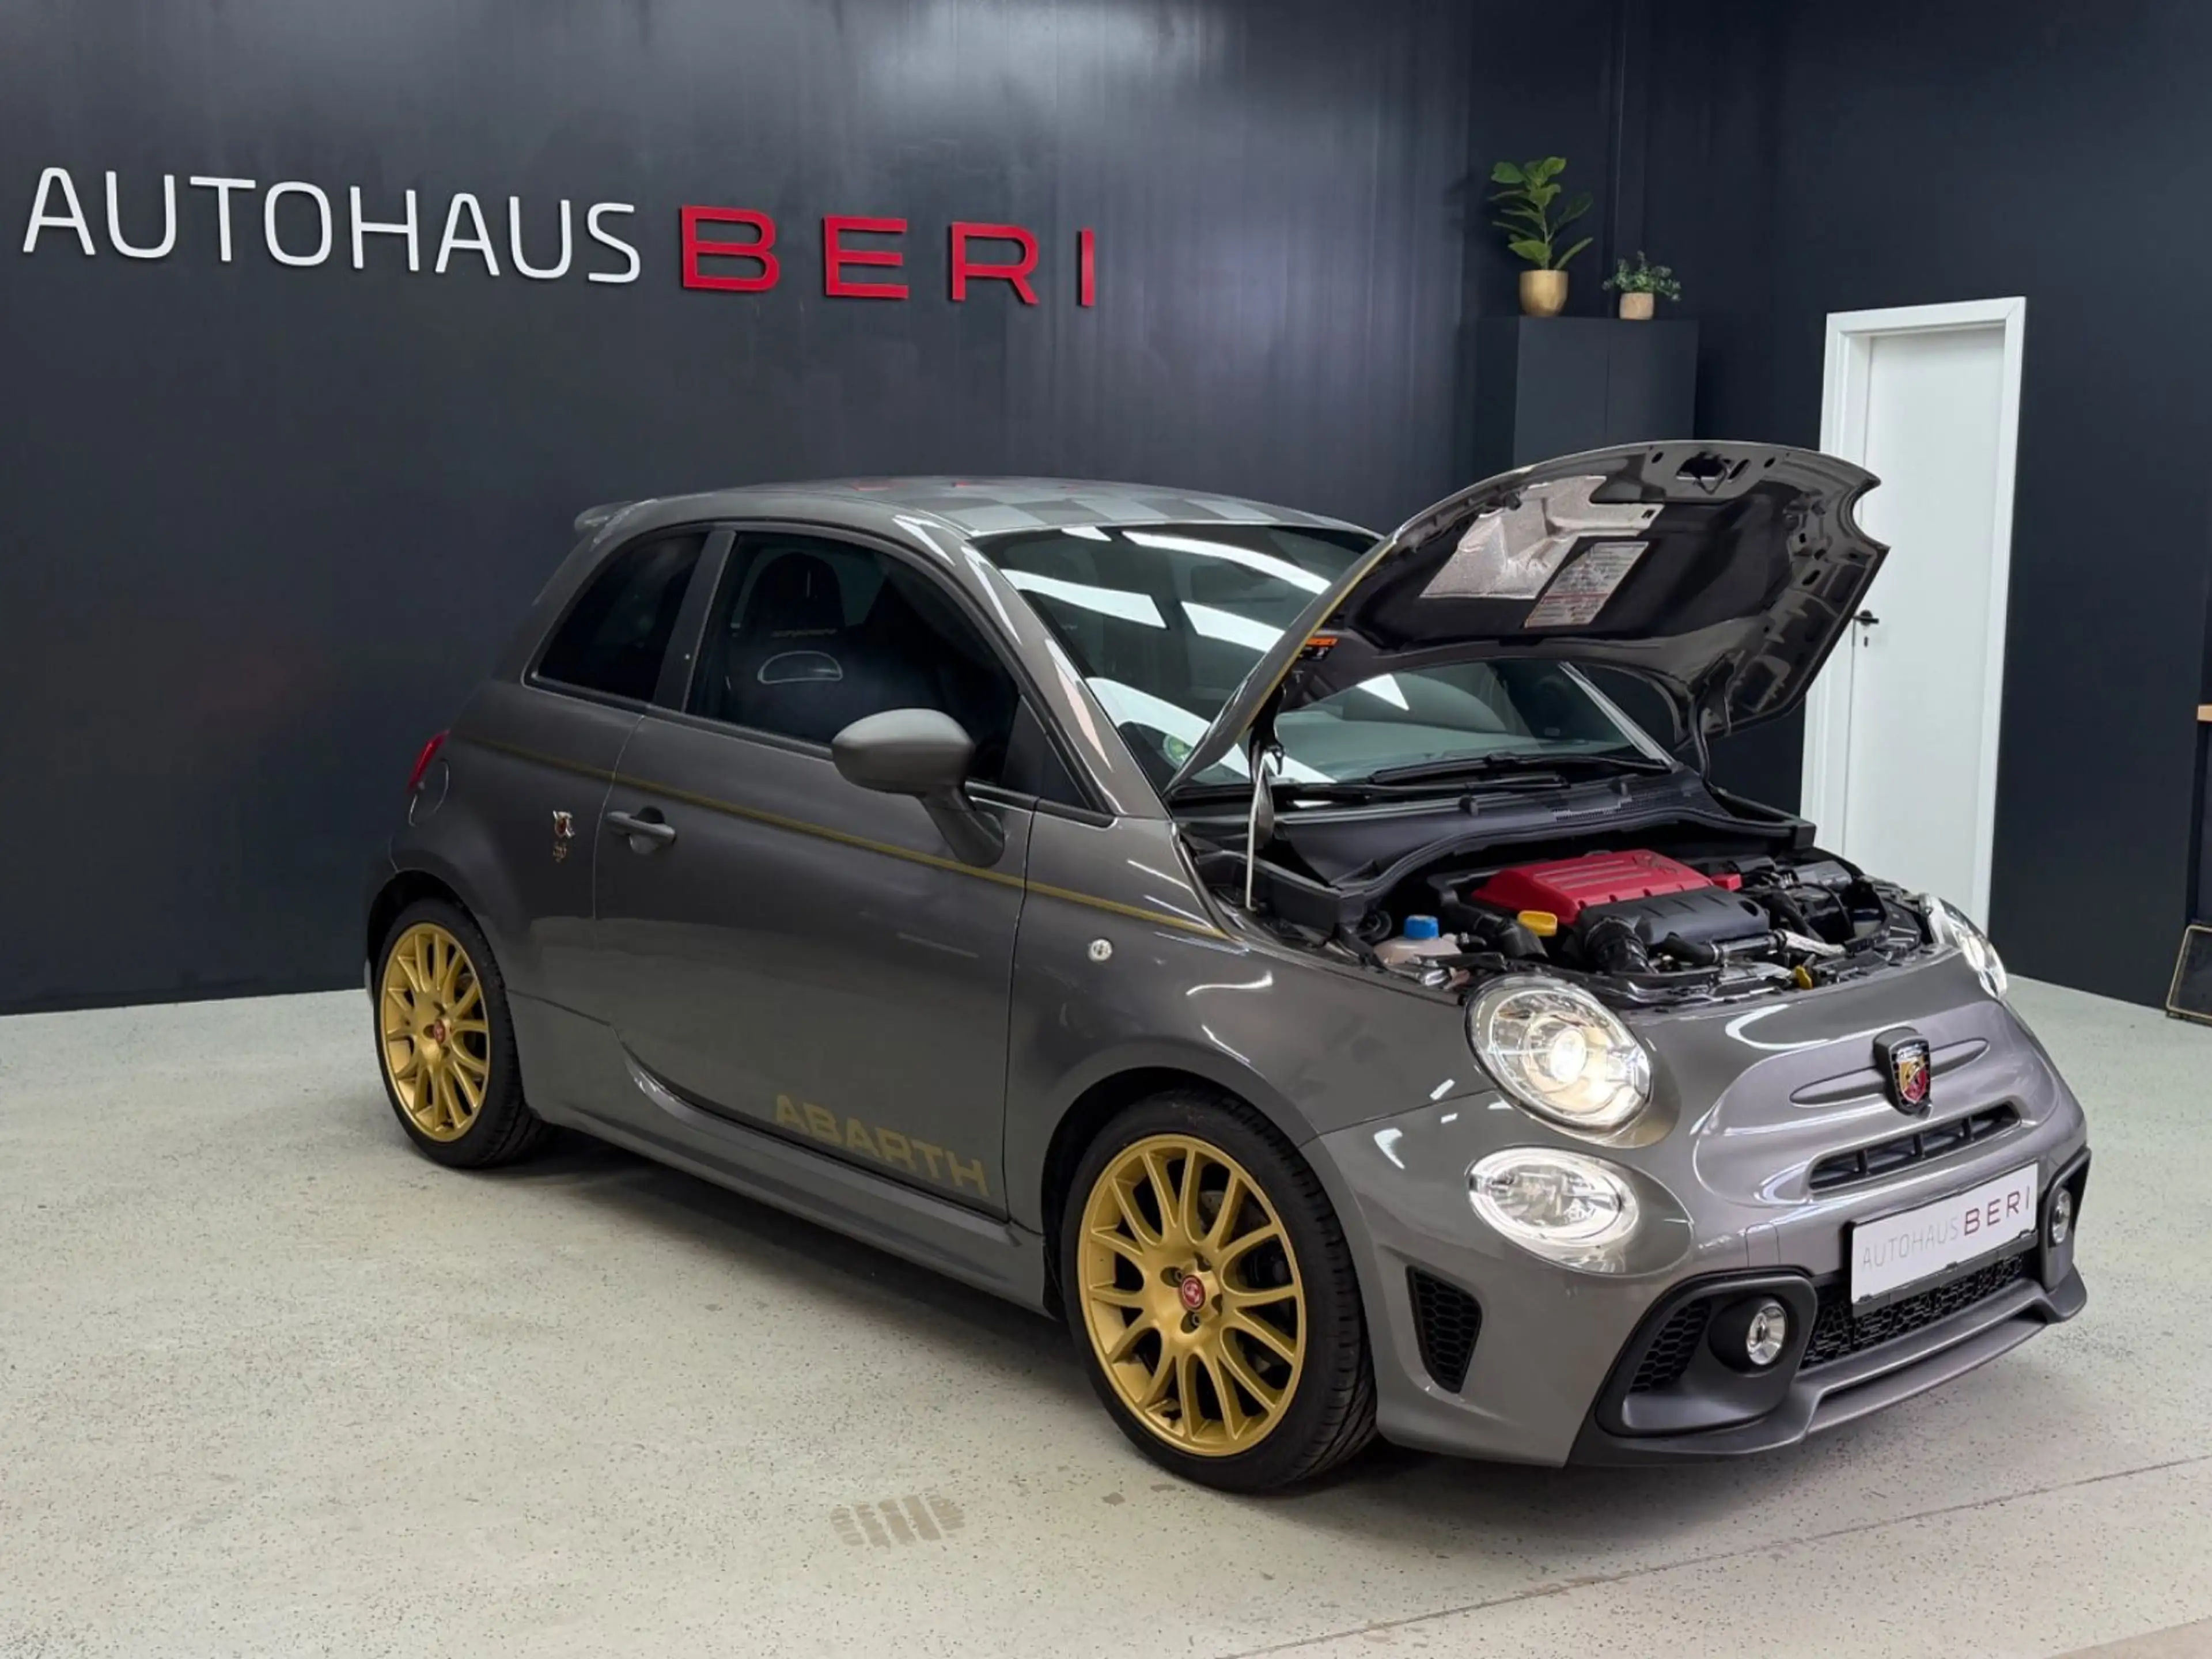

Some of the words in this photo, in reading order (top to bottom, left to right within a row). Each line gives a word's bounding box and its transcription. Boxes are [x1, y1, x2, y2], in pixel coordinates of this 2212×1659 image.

[23, 167, 641, 283] AUTOHAUS
[681, 205, 1095, 306] BERI
[775, 1093, 990, 1197] ABARTH
[1862, 1216, 1959, 1270] AUTOHAUS
[1964, 1185, 2031, 1236] BERI
